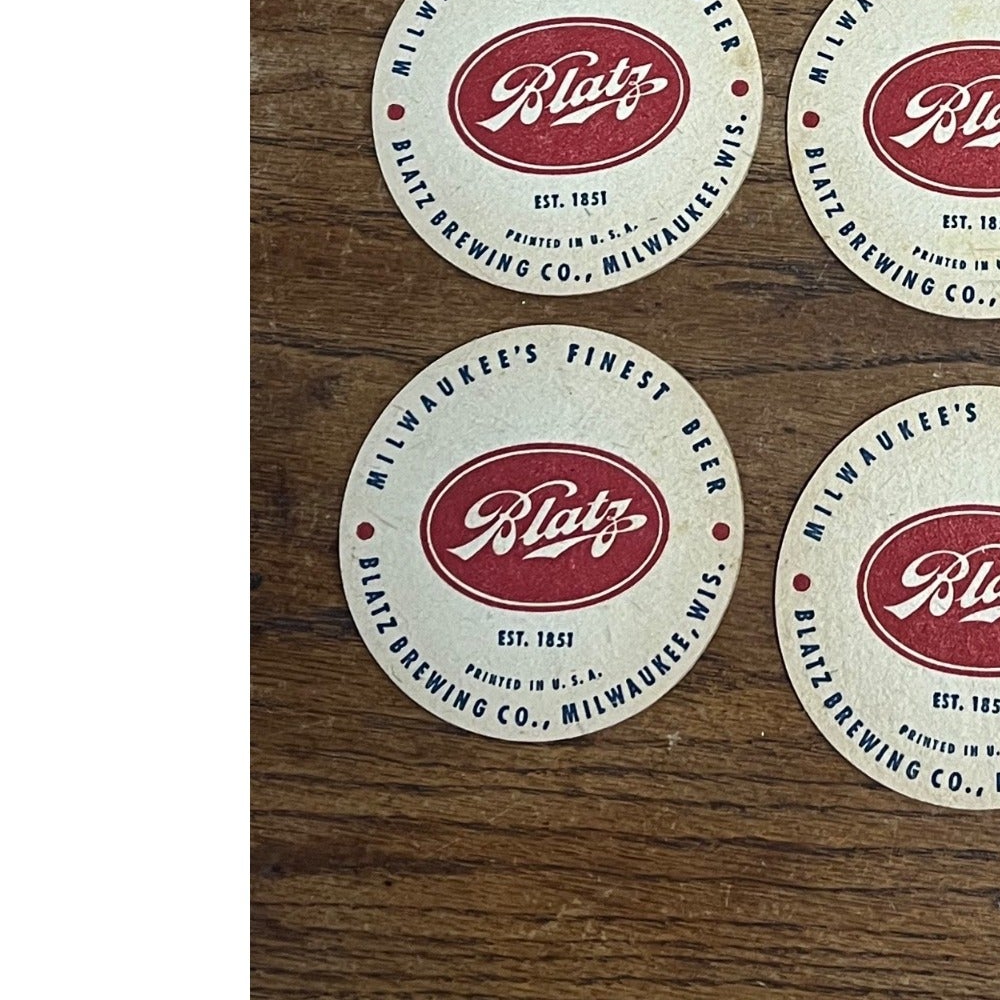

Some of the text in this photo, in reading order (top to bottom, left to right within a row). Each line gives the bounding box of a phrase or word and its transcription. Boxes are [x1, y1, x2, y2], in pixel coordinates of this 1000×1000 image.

[476, 51, 668, 132] Blatz
[392, 115, 747, 283] BLATZ BREWING CO., MILWAUKEE, WIS.
[535, 191, 606, 209] EST. 1851
[943, 215, 972, 230] EST.
[506, 229, 583, 248] PRINTED IN
[805, 148, 844, 218] BLATZ
[839, 221, 935, 295] BREWING
[946, 284, 996, 307] CO.,
[912, 246, 966, 269] PRINTED
[366, 344, 726, 494] MILWAUKEE'S FINEST BEER
[803, 403, 976, 541] MILWAUKEE'S
[448, 480, 647, 560] Blatz
[359, 558, 725, 730] BLATZ BREWING CO., MILWAUKEE, WIS.
[498, 630, 573, 647] EST. 1851
[465, 664, 544, 691] PRINTED IN
[795, 610, 832, 688] BLATZ
[824, 692, 921, 779] BREWING
[931, 769, 983, 797] CO.,
[933, 692, 964, 711] EST.
[899, 725, 978, 756] PRINTED IN
